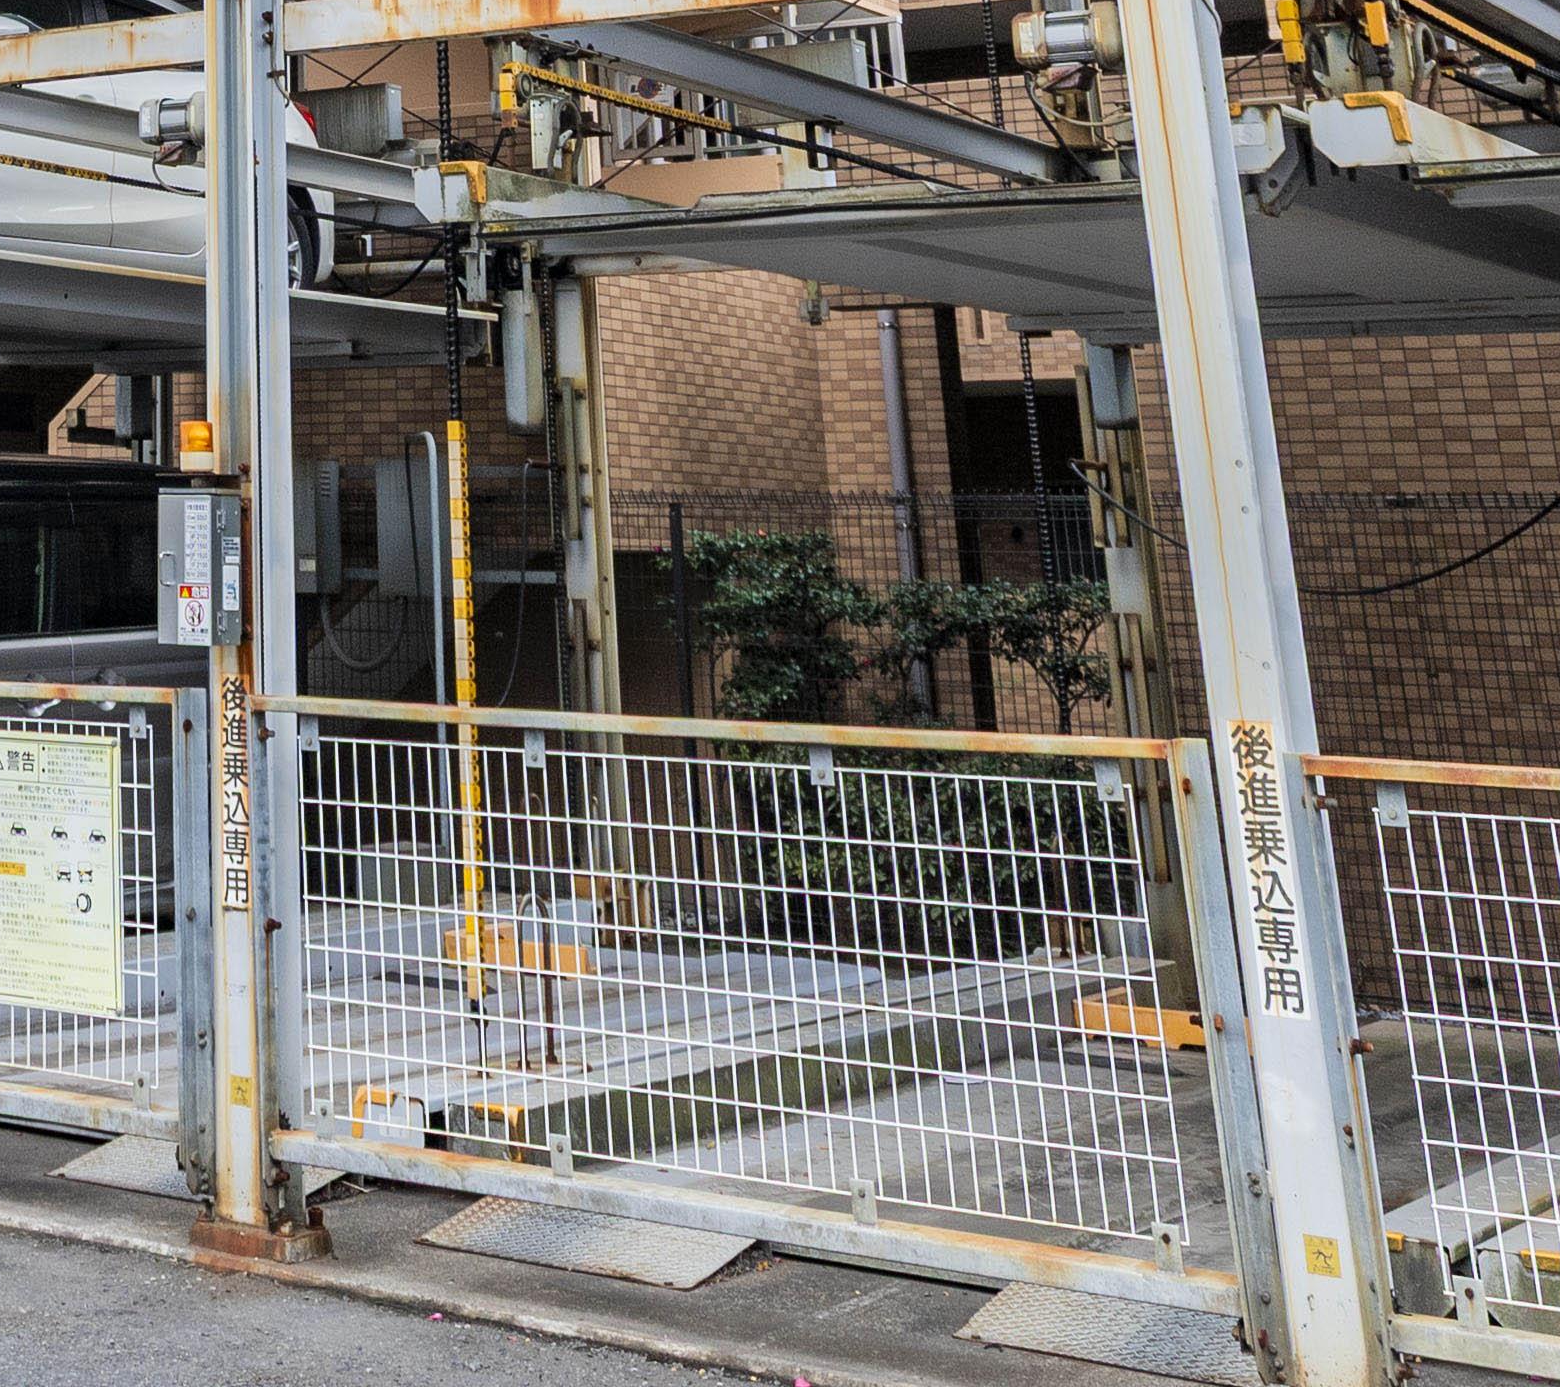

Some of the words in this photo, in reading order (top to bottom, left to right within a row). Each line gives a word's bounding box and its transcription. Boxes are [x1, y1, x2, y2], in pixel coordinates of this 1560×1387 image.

[7, 750, 35, 772] 警告
[222, 676, 250, 904] 後進乗込専用
[1231, 724, 1305, 1014] 後進乗込専用
